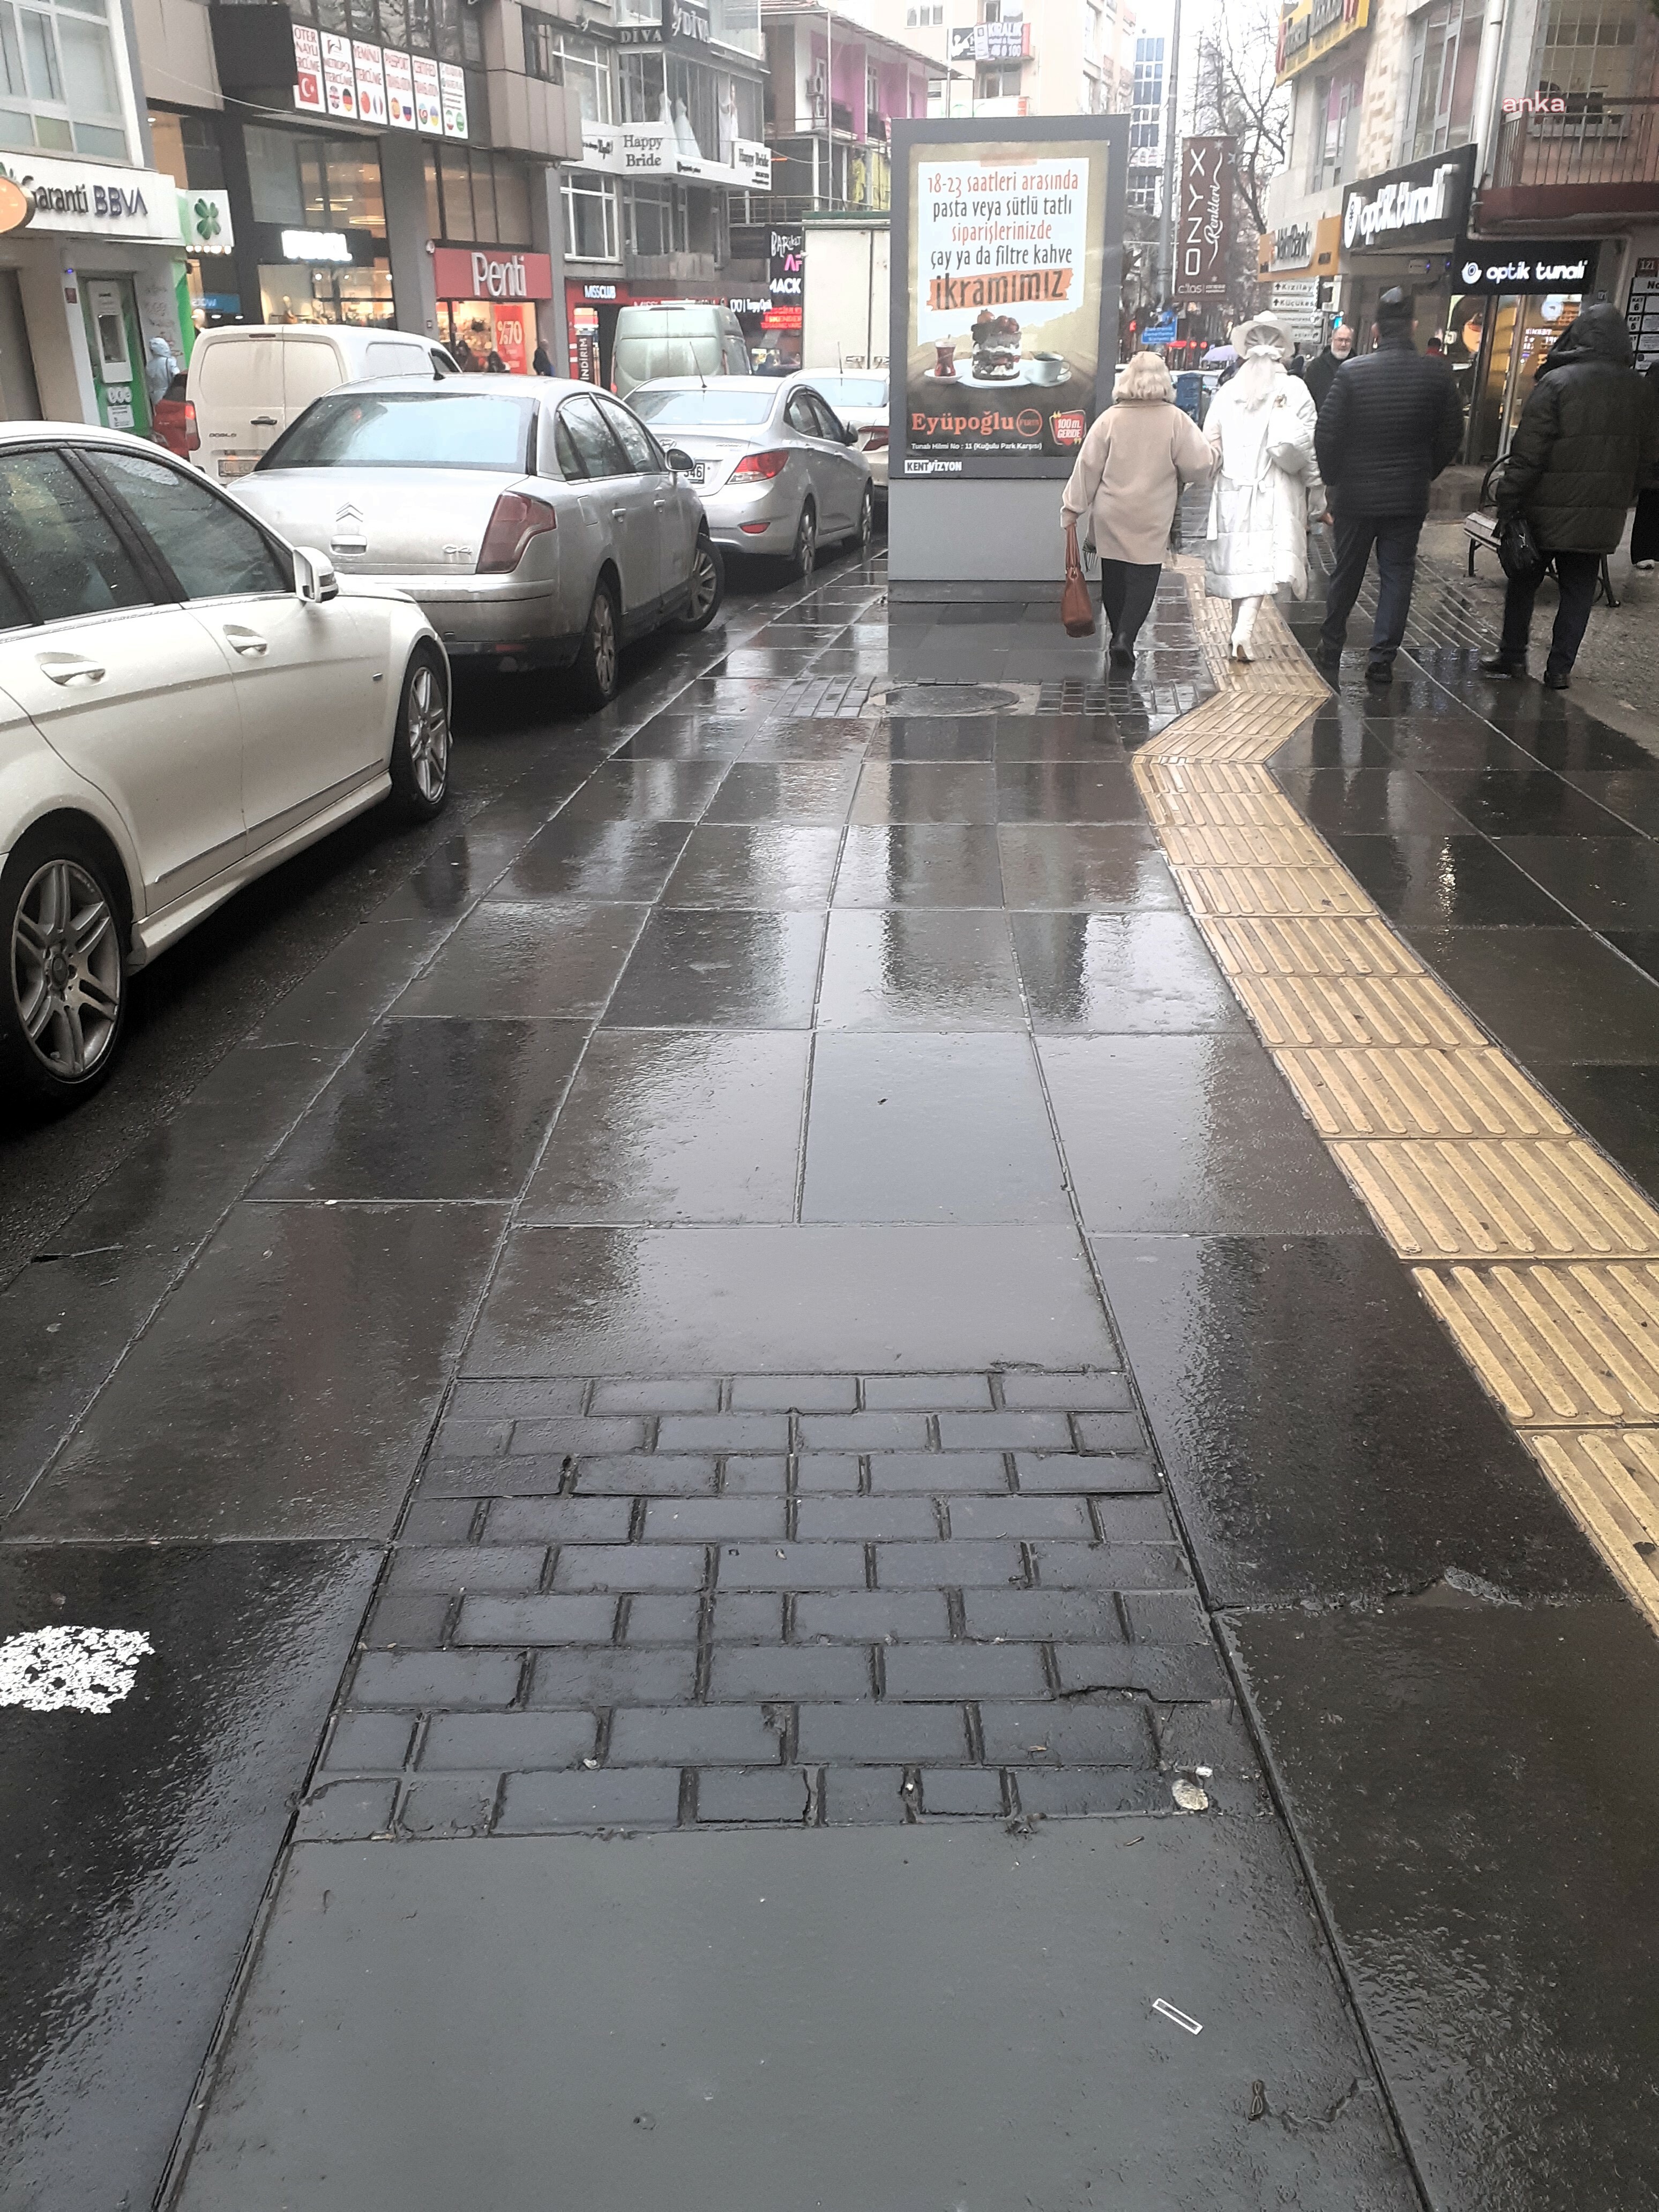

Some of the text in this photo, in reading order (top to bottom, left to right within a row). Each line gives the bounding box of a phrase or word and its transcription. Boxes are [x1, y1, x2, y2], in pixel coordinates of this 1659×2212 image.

[622, 28, 662, 44] DİVA
[623, 134, 664, 151] Happy
[625, 153, 662, 167] Bride
[928, 169, 1079, 198] 18-23 saatleri arasında
[93, 185, 148, 216] BBVA
[933, 195, 1072, 222] pasta veya sütlü tatlı
[1185, 147, 1206, 276] ONYX
[952, 220, 1052, 245] siparişlerinizde
[931, 244, 1073, 270] çay ya da filtre kahve
[471, 252, 527, 296] Penti
[1486, 259, 1589, 285] optik tunali
[936, 270, 1064, 310] ikramımız
[497, 320, 522, 345] %70
[911, 410, 1015, 436] Eyüpoğlu
[442, 543, 473, 556] C4
